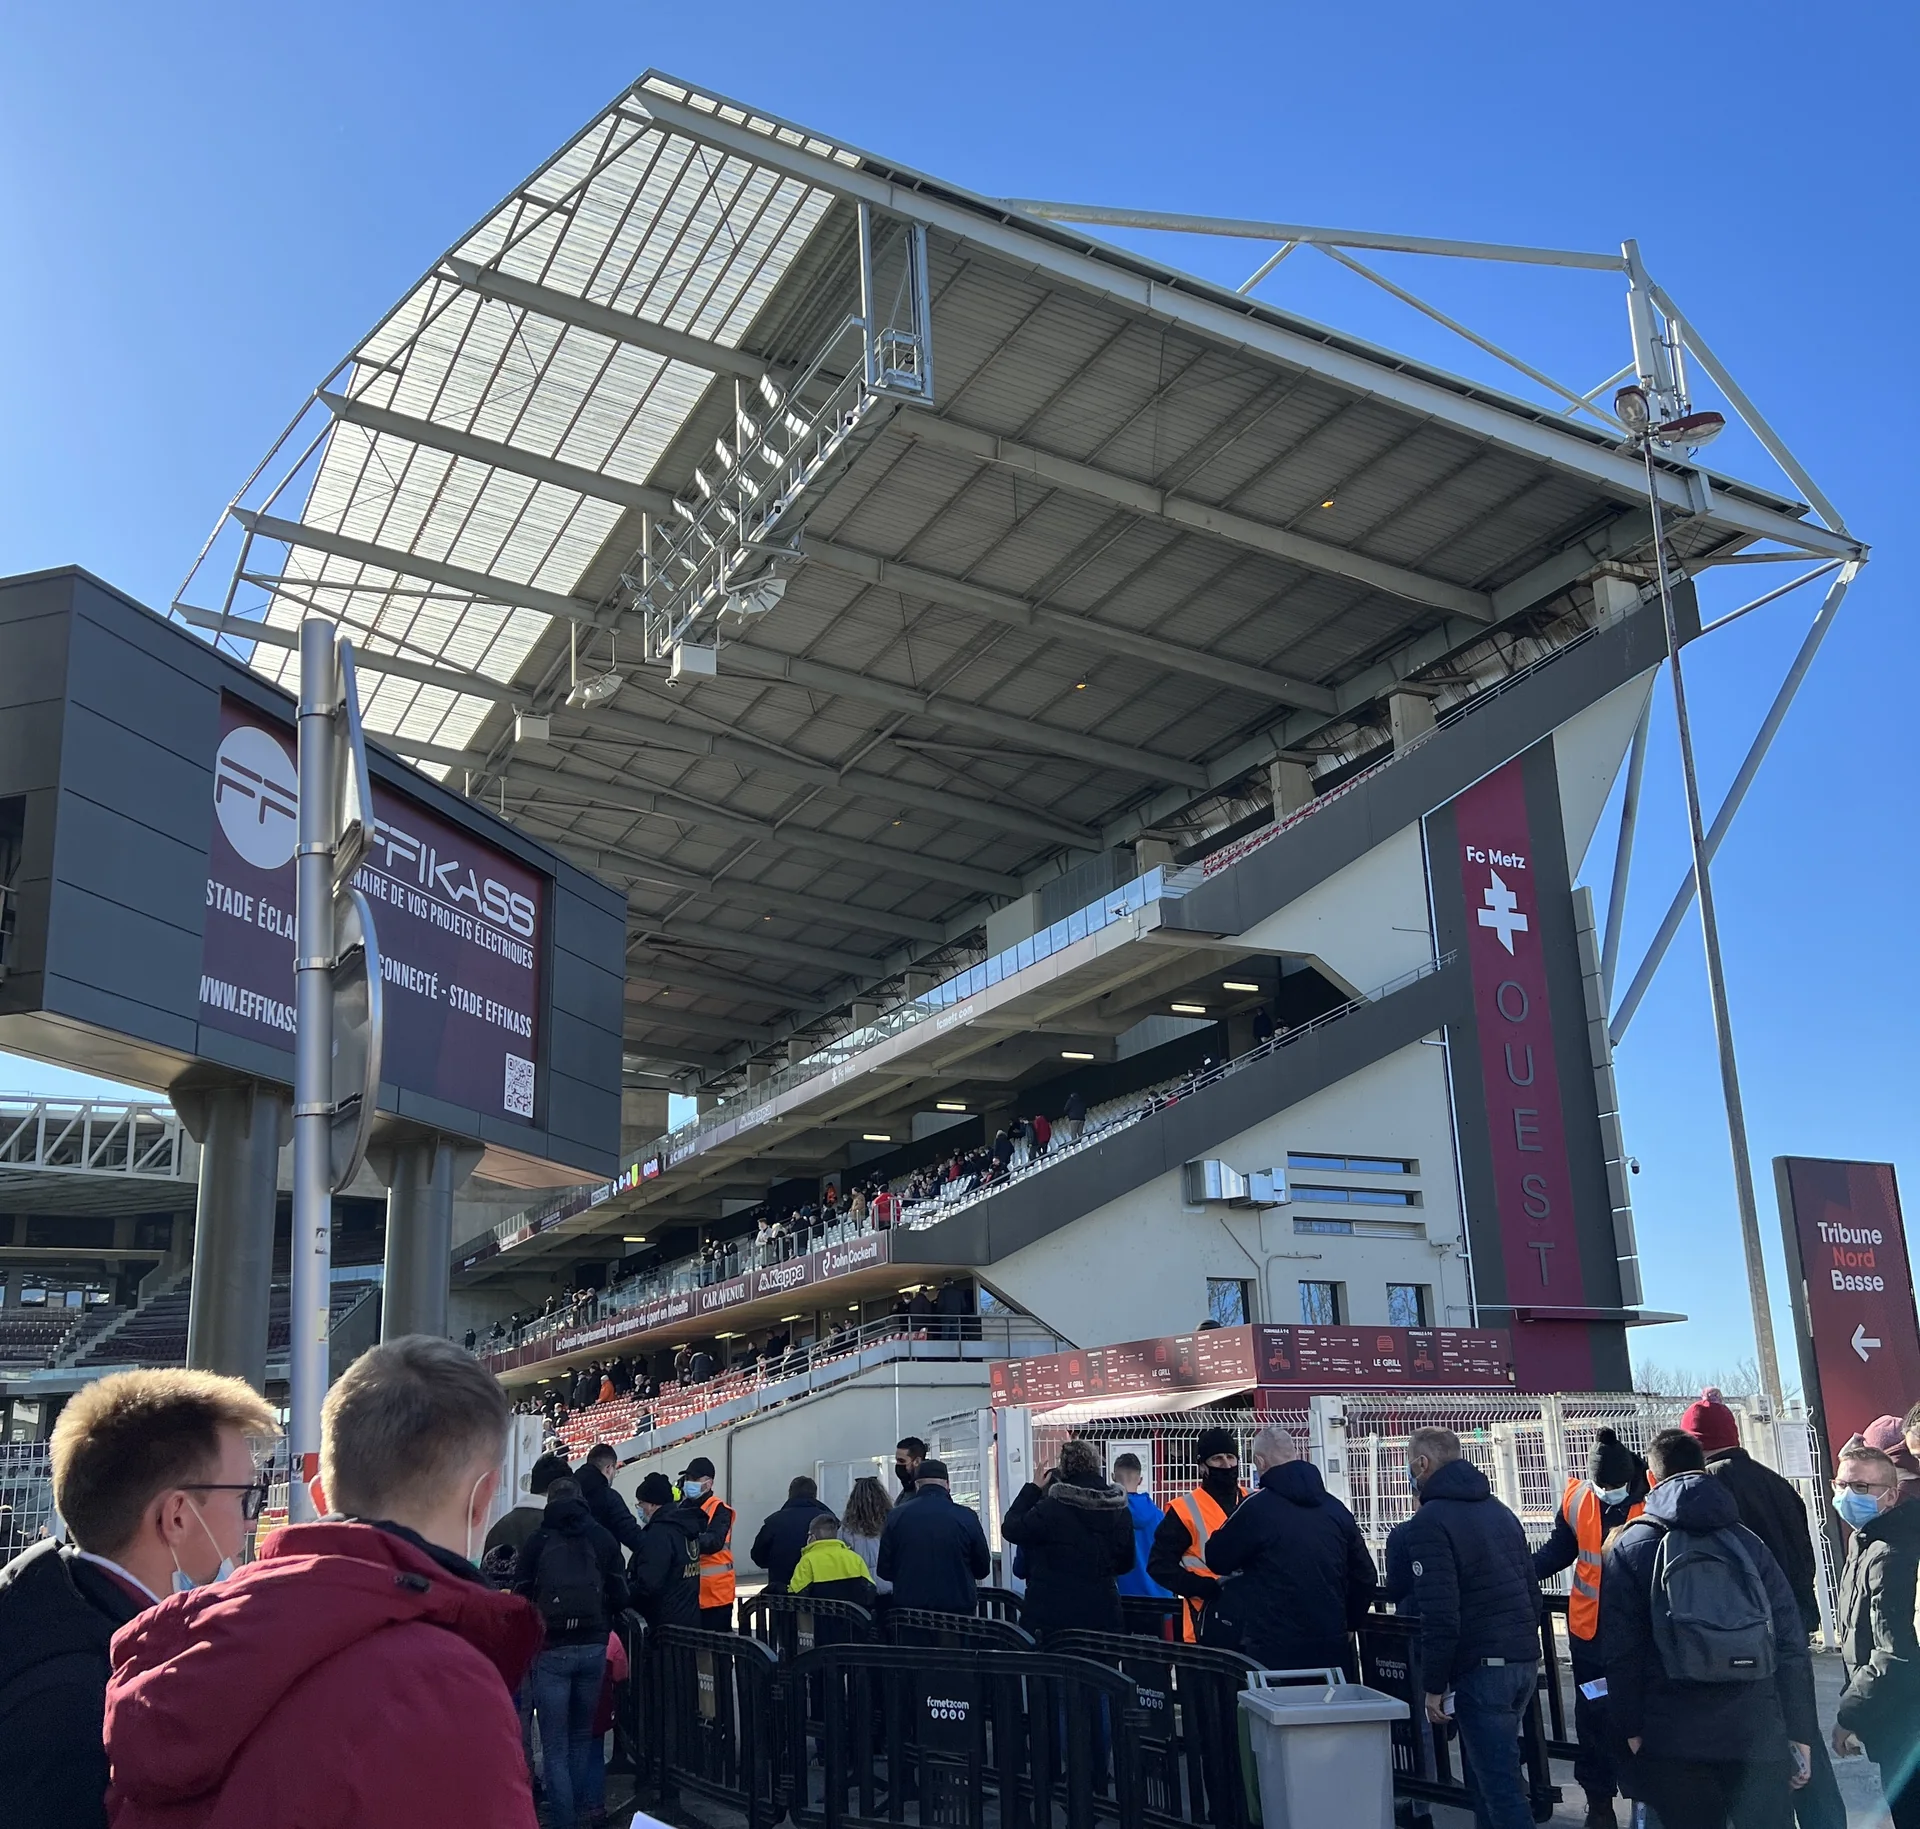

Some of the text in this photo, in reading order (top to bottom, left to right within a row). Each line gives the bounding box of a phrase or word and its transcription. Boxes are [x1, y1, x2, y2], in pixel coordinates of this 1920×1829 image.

[1466, 845, 1526, 869] Fc Metz
[350, 867, 533, 970] NAIRE DE VOS PROJETS ÉLECTRIQUES
[205, 878, 254, 923] STADE
[379, 953, 439, 1000] CONNECTÉ
[449, 984, 483, 1018] STADE
[485, 999, 532, 1039] EFFIKASS
[748, 1104, 772, 1124] Kappa
[1496, 980, 1555, 1287] OUEST
[1817, 1221, 1883, 1245] Tribune
[832, 1242, 877, 1269] John Cockerill
[1832, 1246, 1876, 1268] Nord
[769, 1264, 805, 1288] Kappa
[1830, 1269, 1884, 1292] Basse
[702, 1283, 745, 1309] CAR AVENUE
[555, 1339, 562, 1351] Le
[561, 1333, 577, 1350] Conseil
[615, 1315, 639, 1337] partenaire
[639, 1314, 646, 1326] du
[646, 1309, 660, 1327] sport
[660, 1308, 667, 1320] en
[667, 1300, 689, 1319] Moselle
[1152, 1368, 1171, 1377] LE GRILL
[1373, 1359, 1382, 1367] LE
[1382, 1359, 1402, 1367] GRILL
[1073, 1380, 1084, 1388] GRILL
